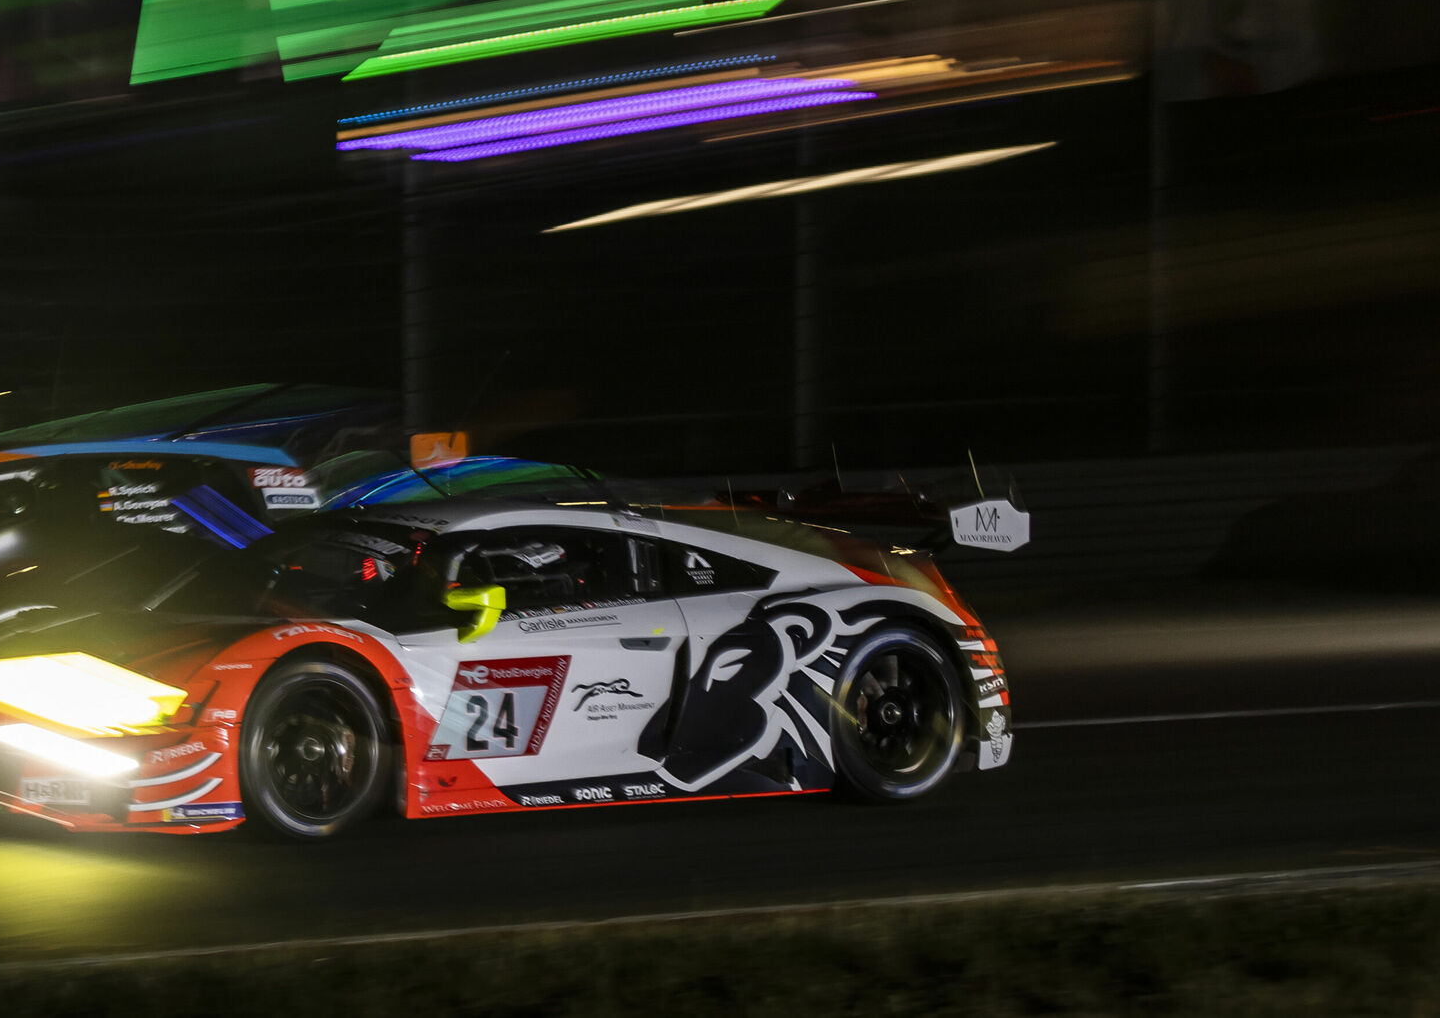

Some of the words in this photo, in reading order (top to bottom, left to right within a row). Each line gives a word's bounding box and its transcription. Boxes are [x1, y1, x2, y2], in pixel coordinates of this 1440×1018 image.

[253, 474, 306, 487] auto
[959, 534, 1012, 543] MANORHAVEN
[518, 618, 567, 633] Carlisle
[567, 614, 618, 624] MANAGEMENT
[491, 667, 553, 679] TotalEnergies
[542, 657, 567, 722] NORDRHEIN
[466, 692, 519, 751] 24
[624, 783, 666, 797] STALOC
[536, 795, 566, 805] RIEDEL
